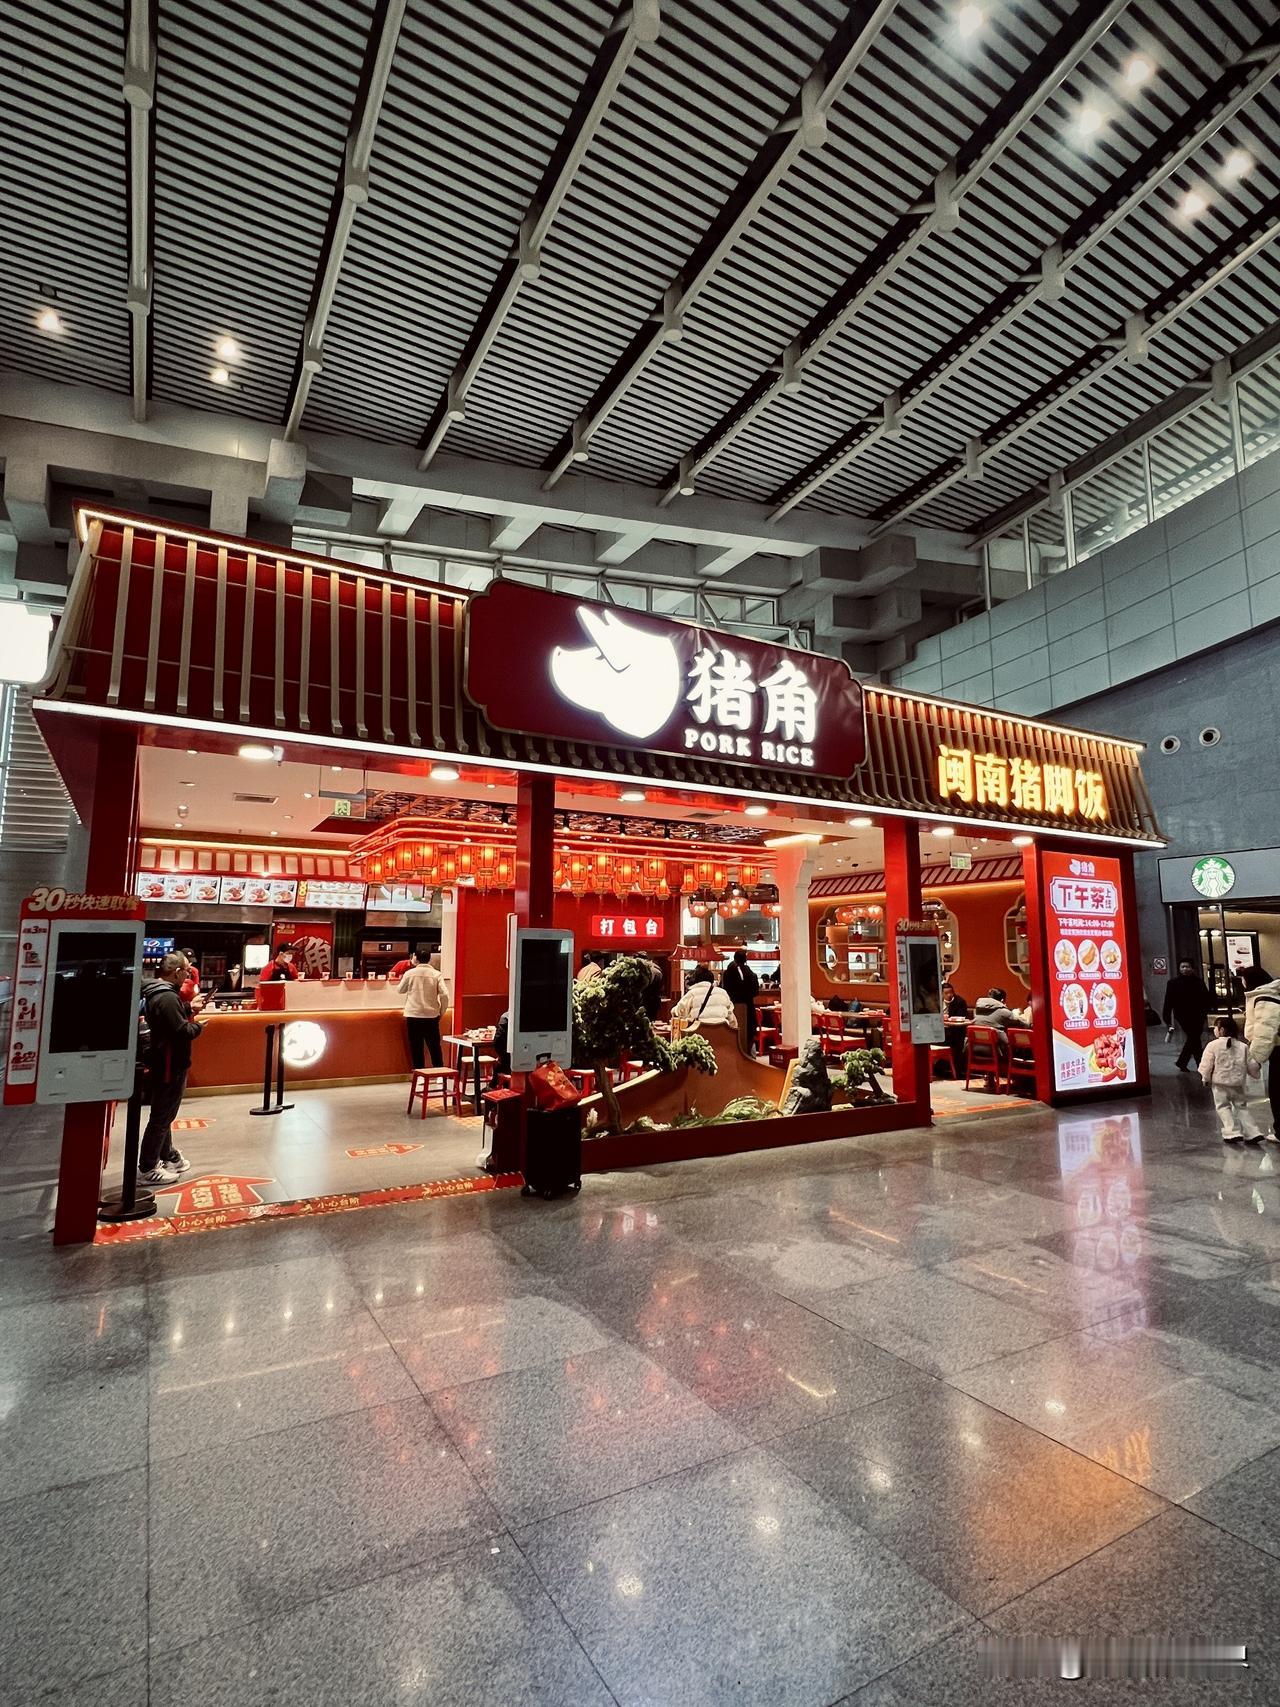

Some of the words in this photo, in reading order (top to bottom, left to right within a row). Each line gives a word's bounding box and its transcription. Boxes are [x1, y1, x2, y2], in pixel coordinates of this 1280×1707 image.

[687, 648, 818, 743] 猪角
[684, 728, 752, 758] PORK
[761, 740, 815, 768] RICE
[937, 743, 1109, 821] 闽南猪脚饭
[1057, 884, 1105, 910] 下午茶
[600, 918, 658, 935] 打包台
[435, 1181, 474, 1193] 小心台阶
[317, 1197, 360, 1209] 小心台阶
[178, 1215, 228, 1229] 小心台阶
